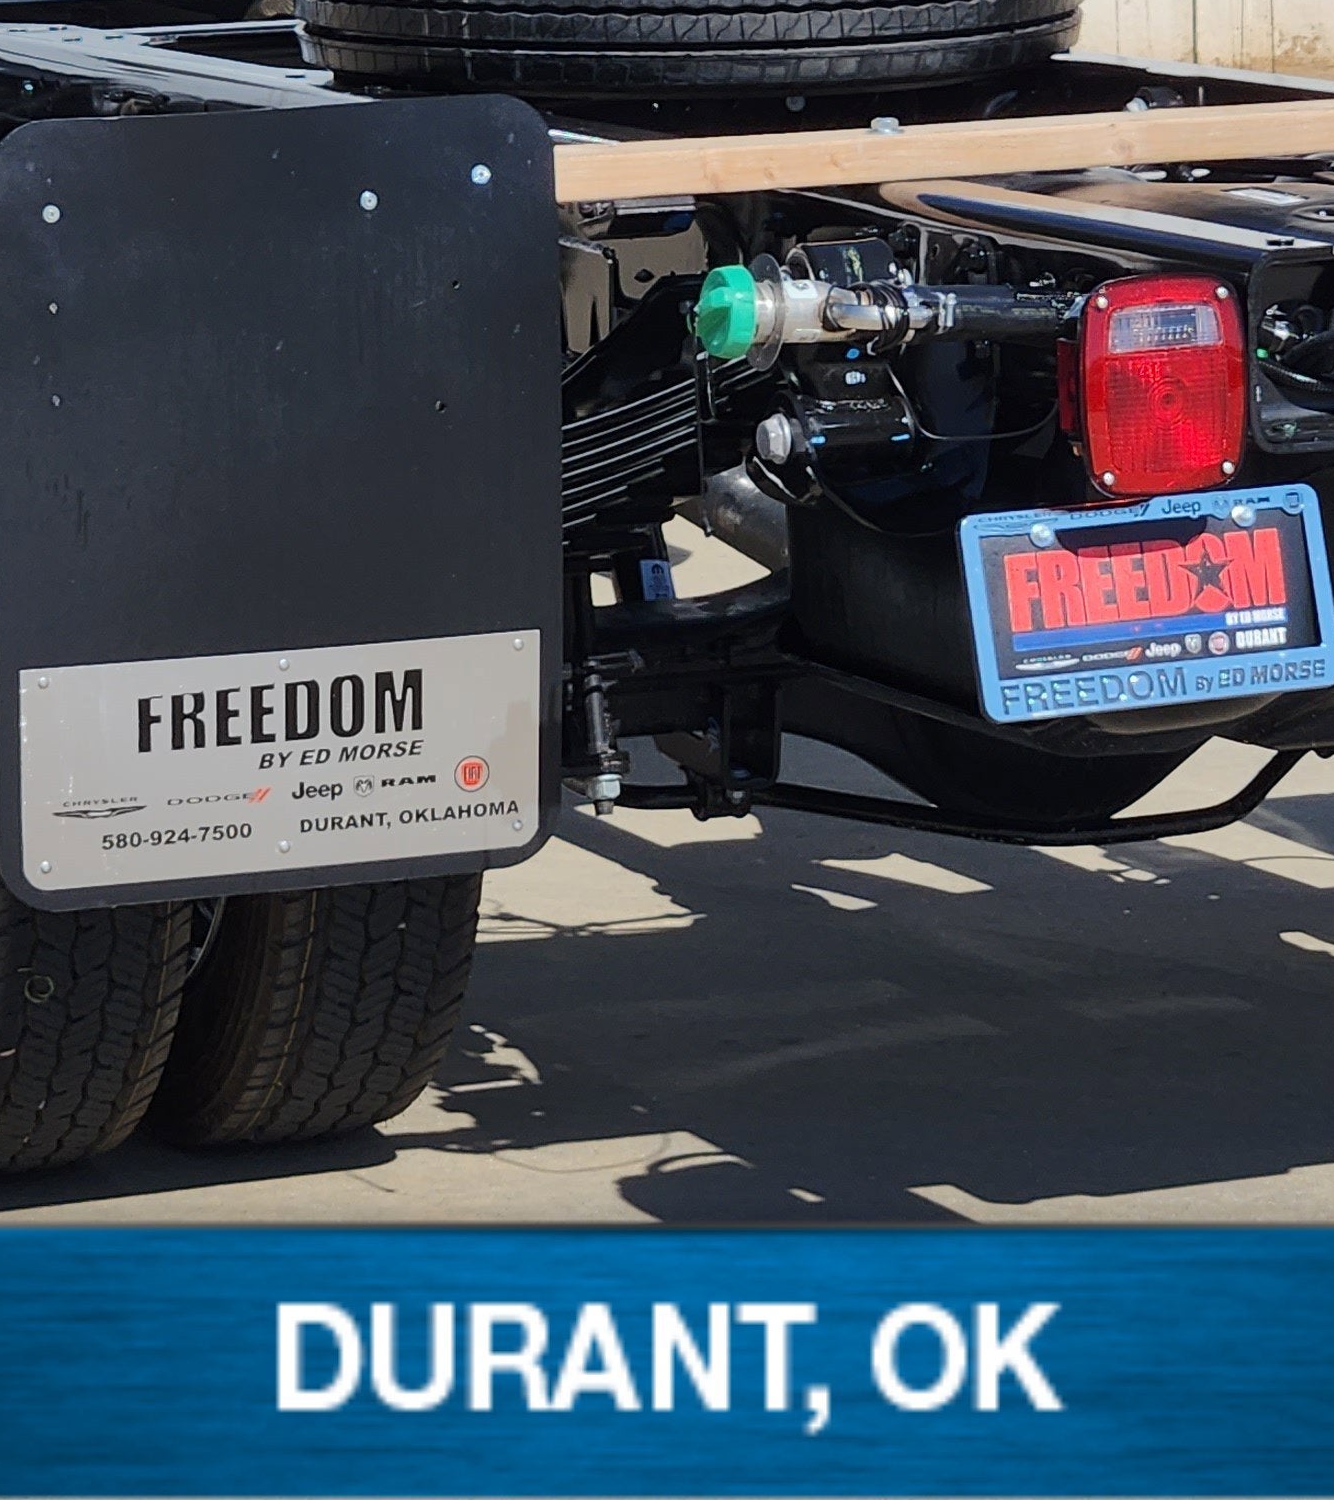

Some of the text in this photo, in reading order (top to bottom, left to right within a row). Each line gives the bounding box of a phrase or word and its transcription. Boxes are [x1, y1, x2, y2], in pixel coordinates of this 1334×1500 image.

[1161, 499, 1202, 517] Jeep
[1002, 526, 1287, 634] FREEDOM
[1144, 642, 1182, 659] Jeep
[1235, 626, 1287, 649] DURANT
[1000, 666, 1188, 716] FREEDOM
[1219, 667, 1245, 689] ED
[1251, 658, 1326, 686] MORSE
[136, 668, 424, 754] FREEDOM
[258, 739, 425, 770] BY ED MORSE
[62, 796, 139, 808] CHRYSLER
[291, 781, 344, 802] Jeep
[380, 774, 437, 788] RAM
[299, 800, 520, 834] DURANT, OKLAHOMA
[101, 822, 253, 851] 580-924-7500
